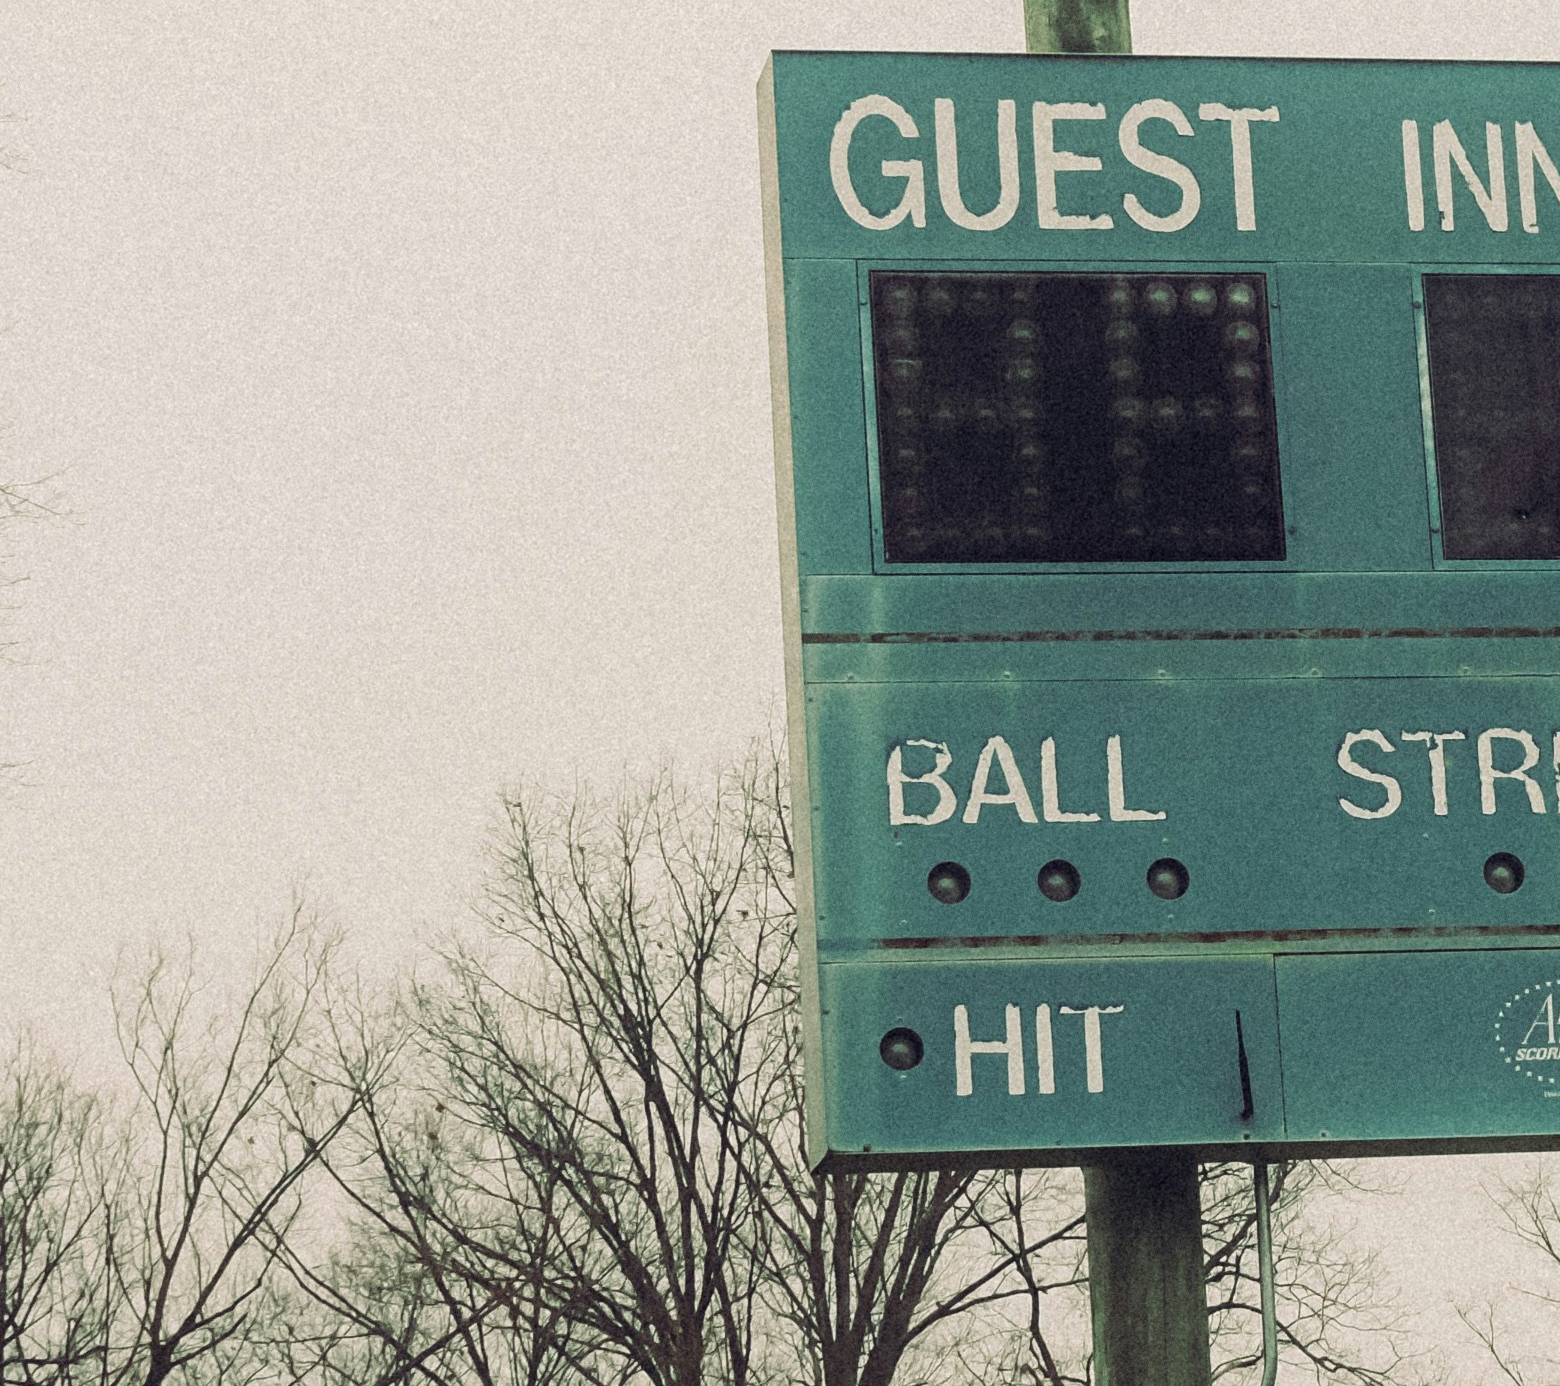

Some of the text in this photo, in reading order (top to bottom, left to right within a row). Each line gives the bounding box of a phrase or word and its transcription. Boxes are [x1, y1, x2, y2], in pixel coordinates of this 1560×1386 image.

[829, 94, 1280, 233] GUEST
[886, 735, 1167, 825] BALL
[954, 1003, 1124, 1096] HIT
